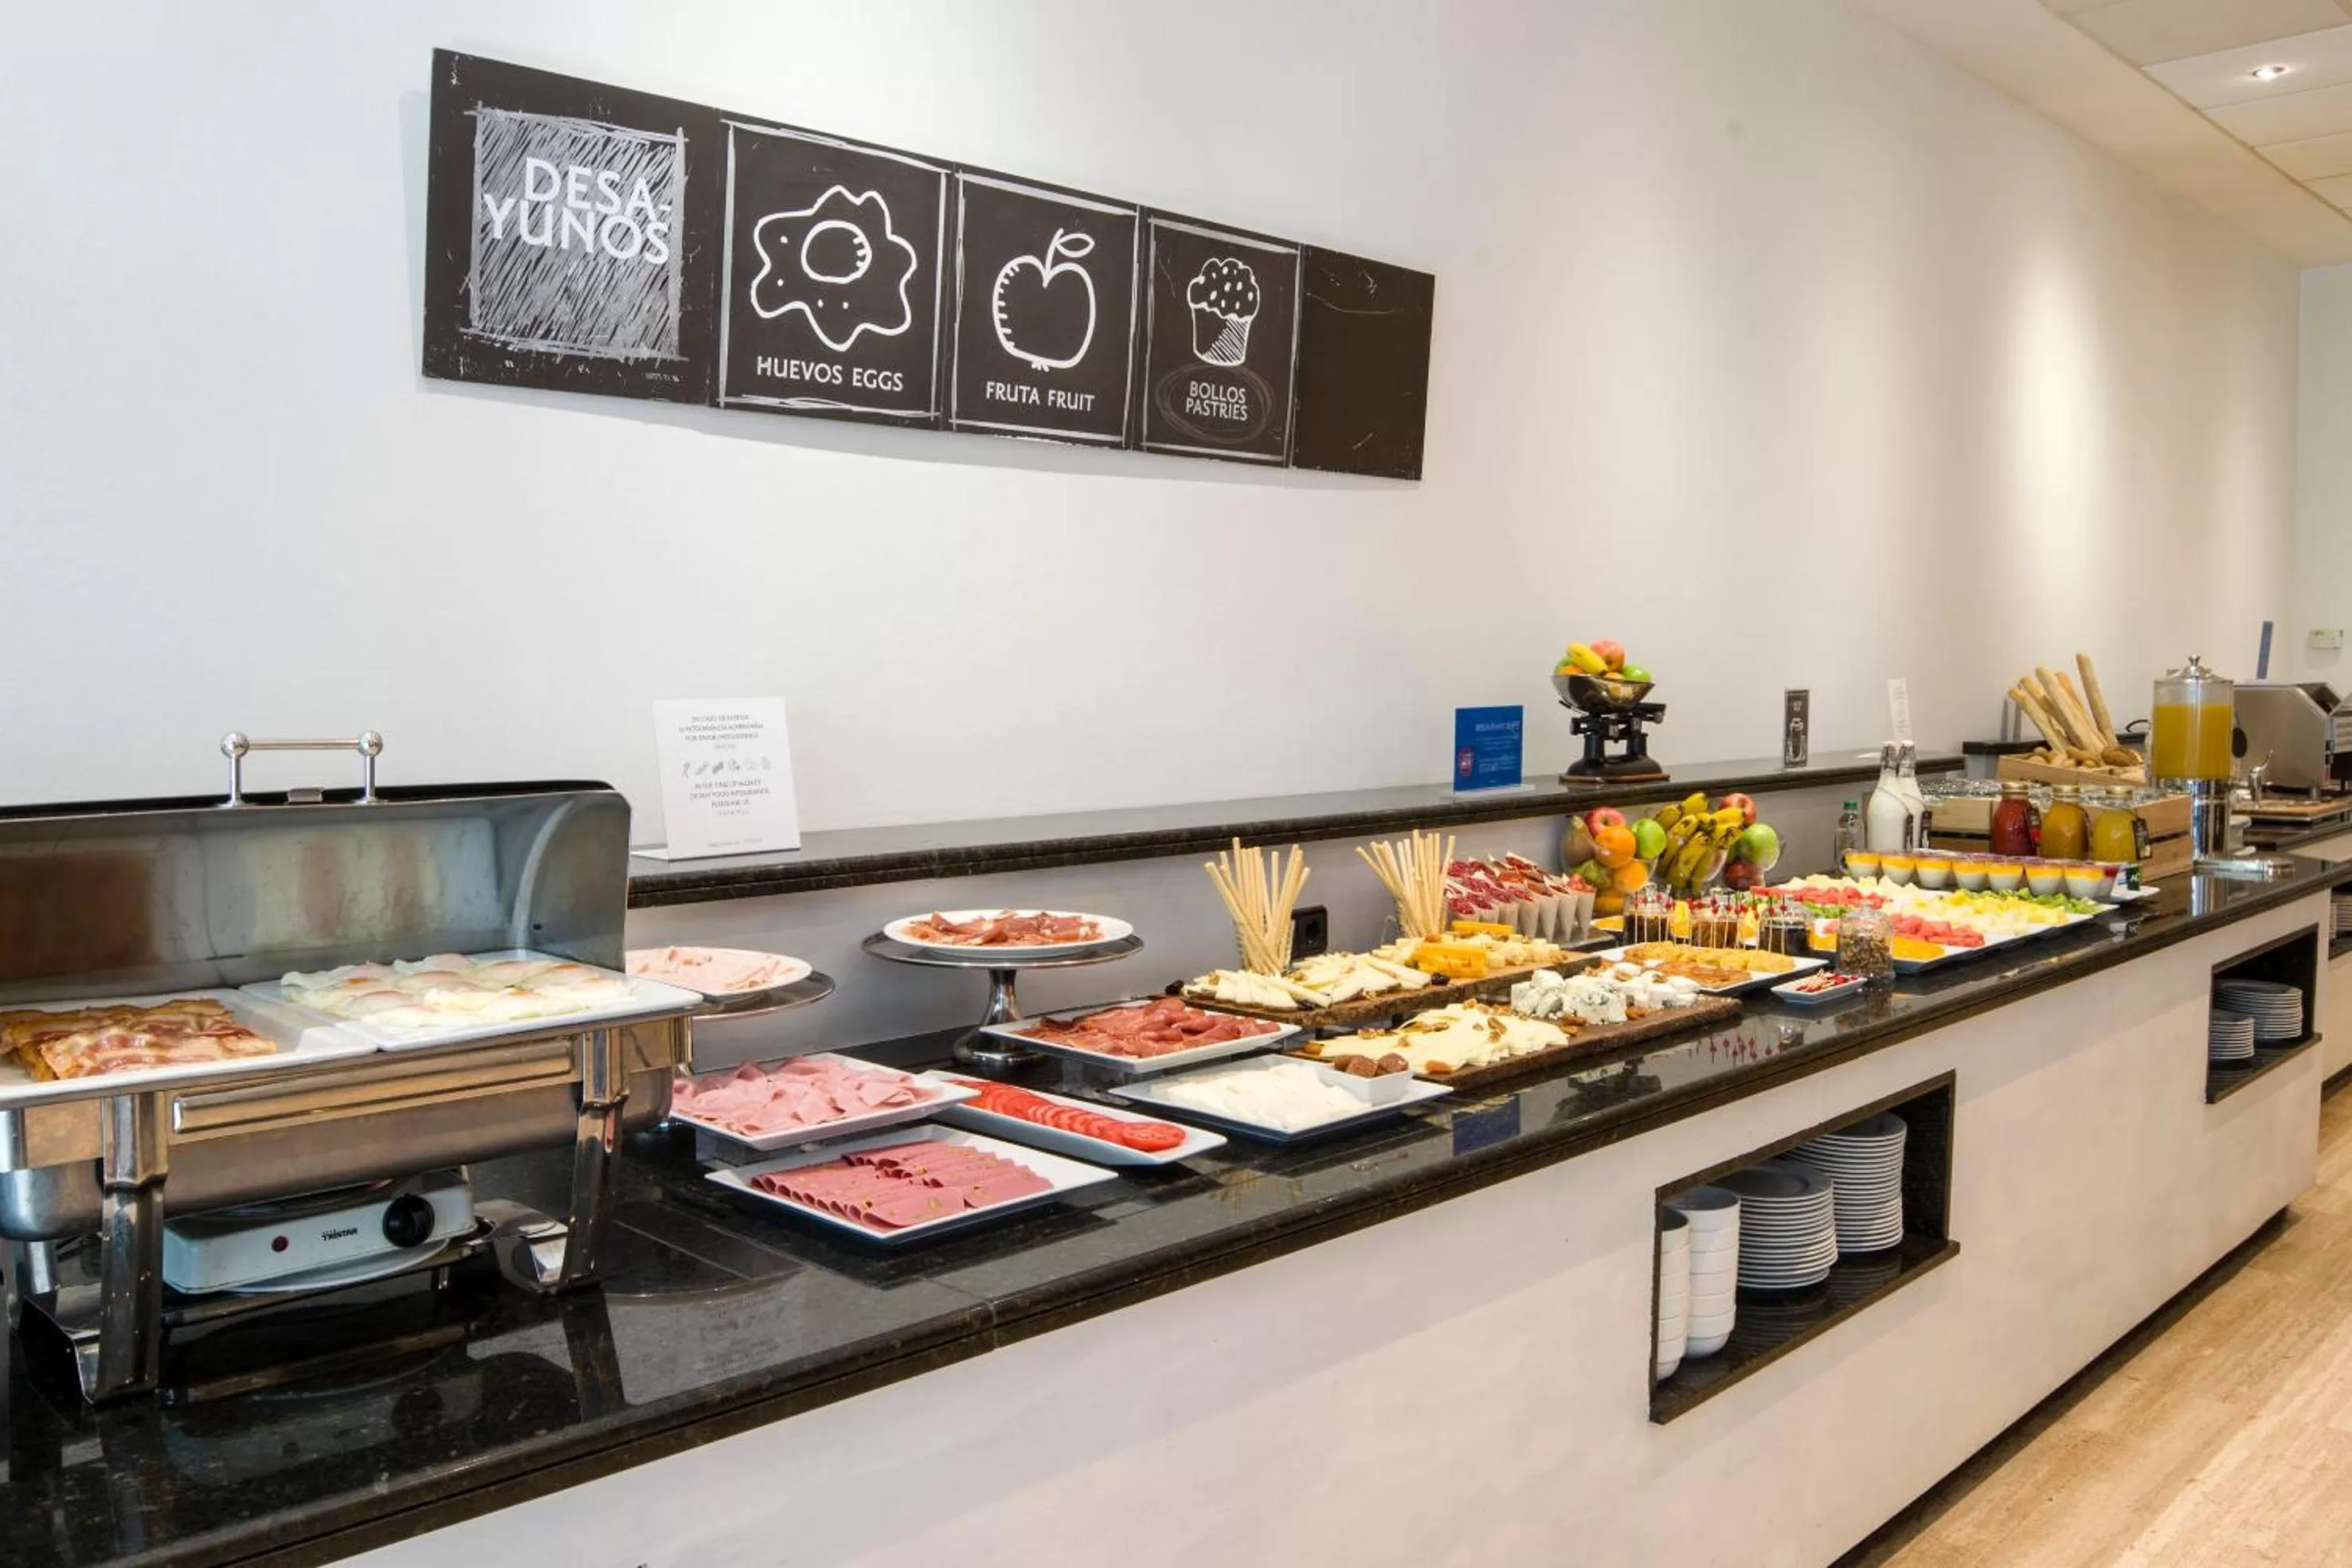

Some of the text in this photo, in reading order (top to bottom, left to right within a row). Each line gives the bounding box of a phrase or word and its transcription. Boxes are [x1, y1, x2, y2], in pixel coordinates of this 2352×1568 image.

[525, 157, 671, 222] DESA-
[483, 193, 670, 264] YUNOS
[756, 354, 904, 392] HUEVOS EGGS
[985, 381, 1095, 412] FRUTA FRUIT
[1185, 397, 1248, 421] PASTRIES
[1189, 380, 1246, 404] BOLLOS
